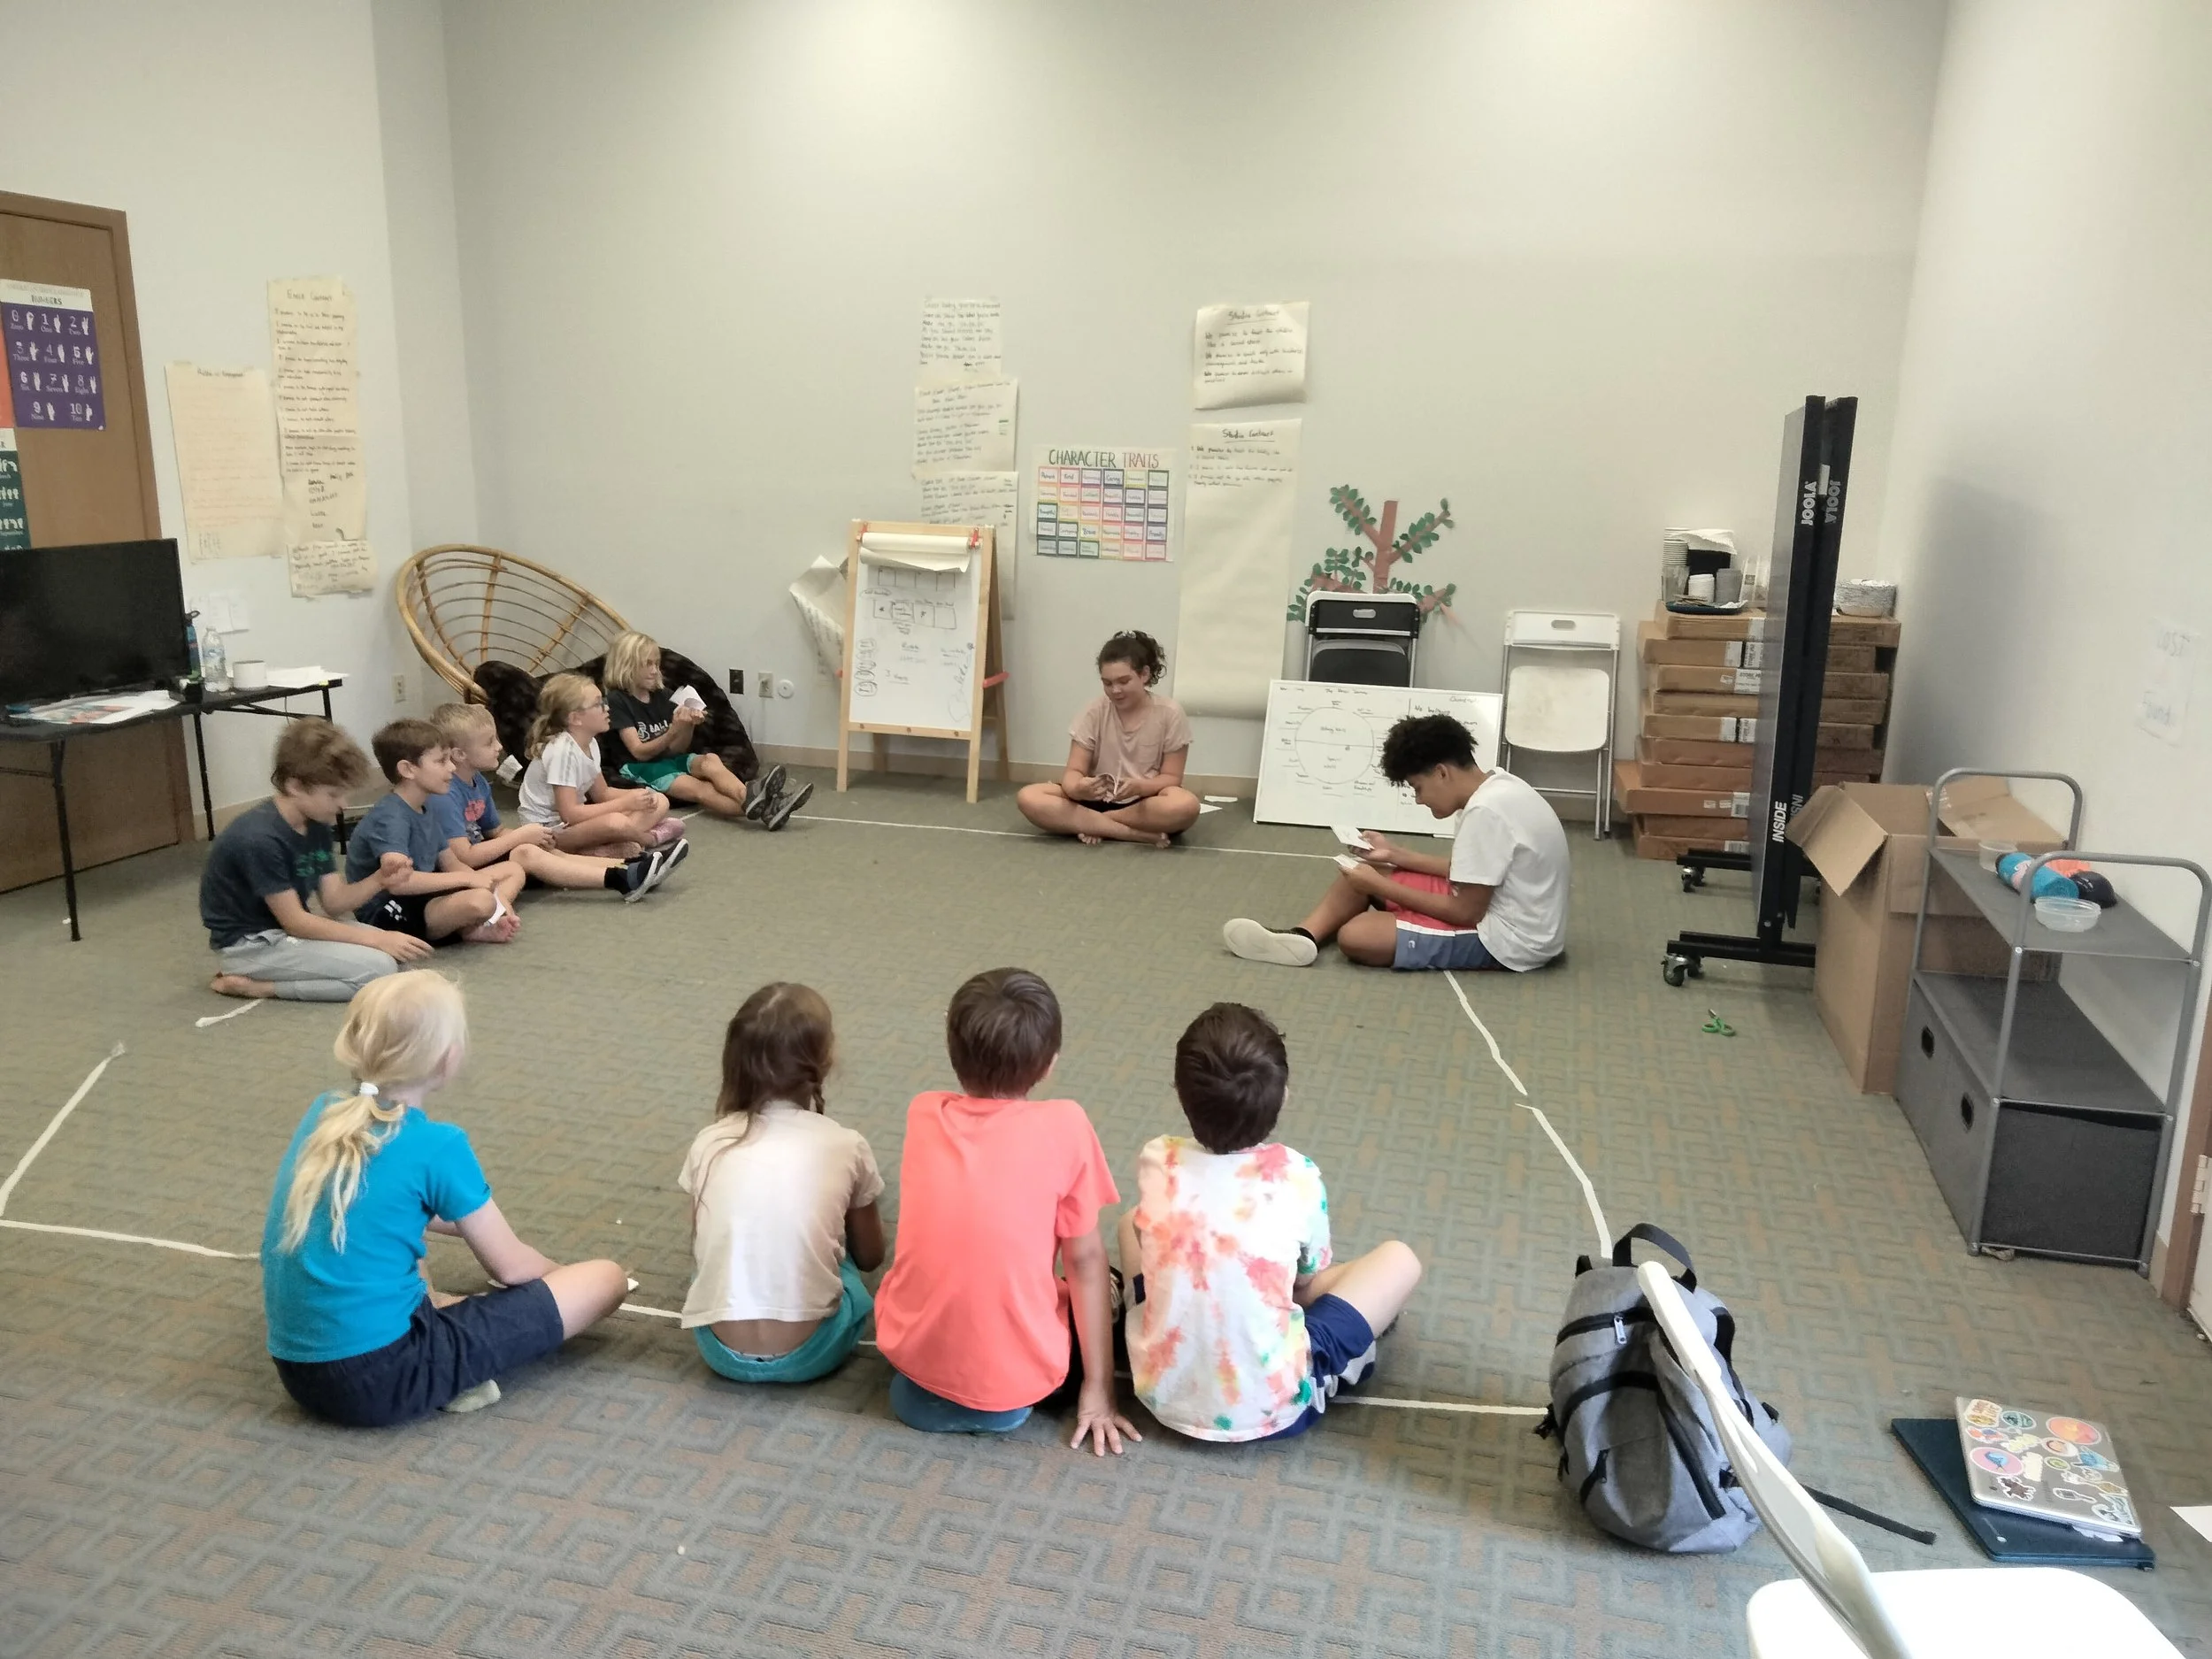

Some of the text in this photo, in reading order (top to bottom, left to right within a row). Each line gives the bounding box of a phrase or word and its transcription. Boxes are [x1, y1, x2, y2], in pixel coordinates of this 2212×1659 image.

[11, 310, 19, 322] 0
[42, 313, 49, 326] 1
[70, 316, 77, 327] 2
[45, 343, 53, 356] 4
[19, 371, 27, 383] 6
[77, 374, 84, 387] 8
[33, 401, 41, 413] 9
[70, 403, 82, 415] 10
[1049, 449, 1158, 468] CHARACTER TRAITS
[1801, 481, 1816, 526] JOOLA
[1824, 480, 1840, 523] JOOLA
[1790, 793, 1804, 817] INS
[1772, 801, 1787, 843] INSIDE
